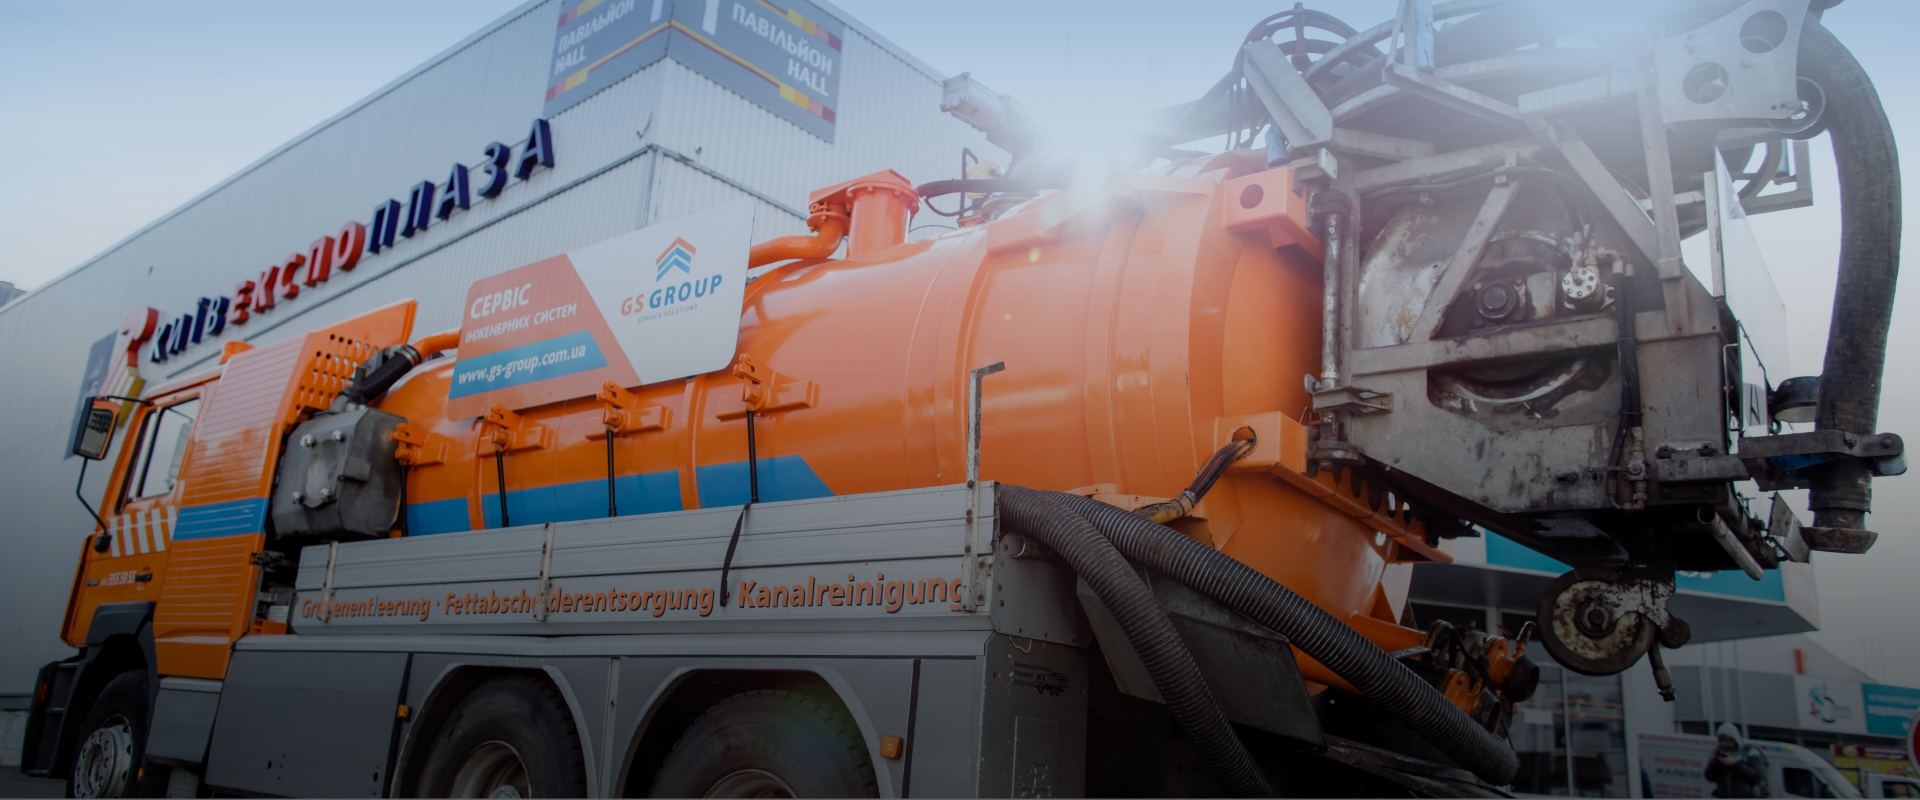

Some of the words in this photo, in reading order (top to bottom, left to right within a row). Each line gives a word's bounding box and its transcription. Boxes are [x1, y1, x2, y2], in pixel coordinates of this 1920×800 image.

[732, 2, 833, 76] ПАВІЛЬЙОН
[555, 45, 586, 76] HALL
[787, 59, 830, 98] HALL
[470, 282, 532, 320] СЕРВІС
[621, 293, 645, 316] GS
[649, 274, 723, 309] GROUP
[637, 310, 663, 324] SERVICE
[663, 303, 698, 318] SOLUTIONS
[465, 314, 532, 344] ІНЖЕНЕРНИХ
[533, 302, 578, 326] СИСТЕМ
[458, 345, 587, 385] www.gs-group.com.ua
[738, 573, 963, 613] Kanalreinigung
